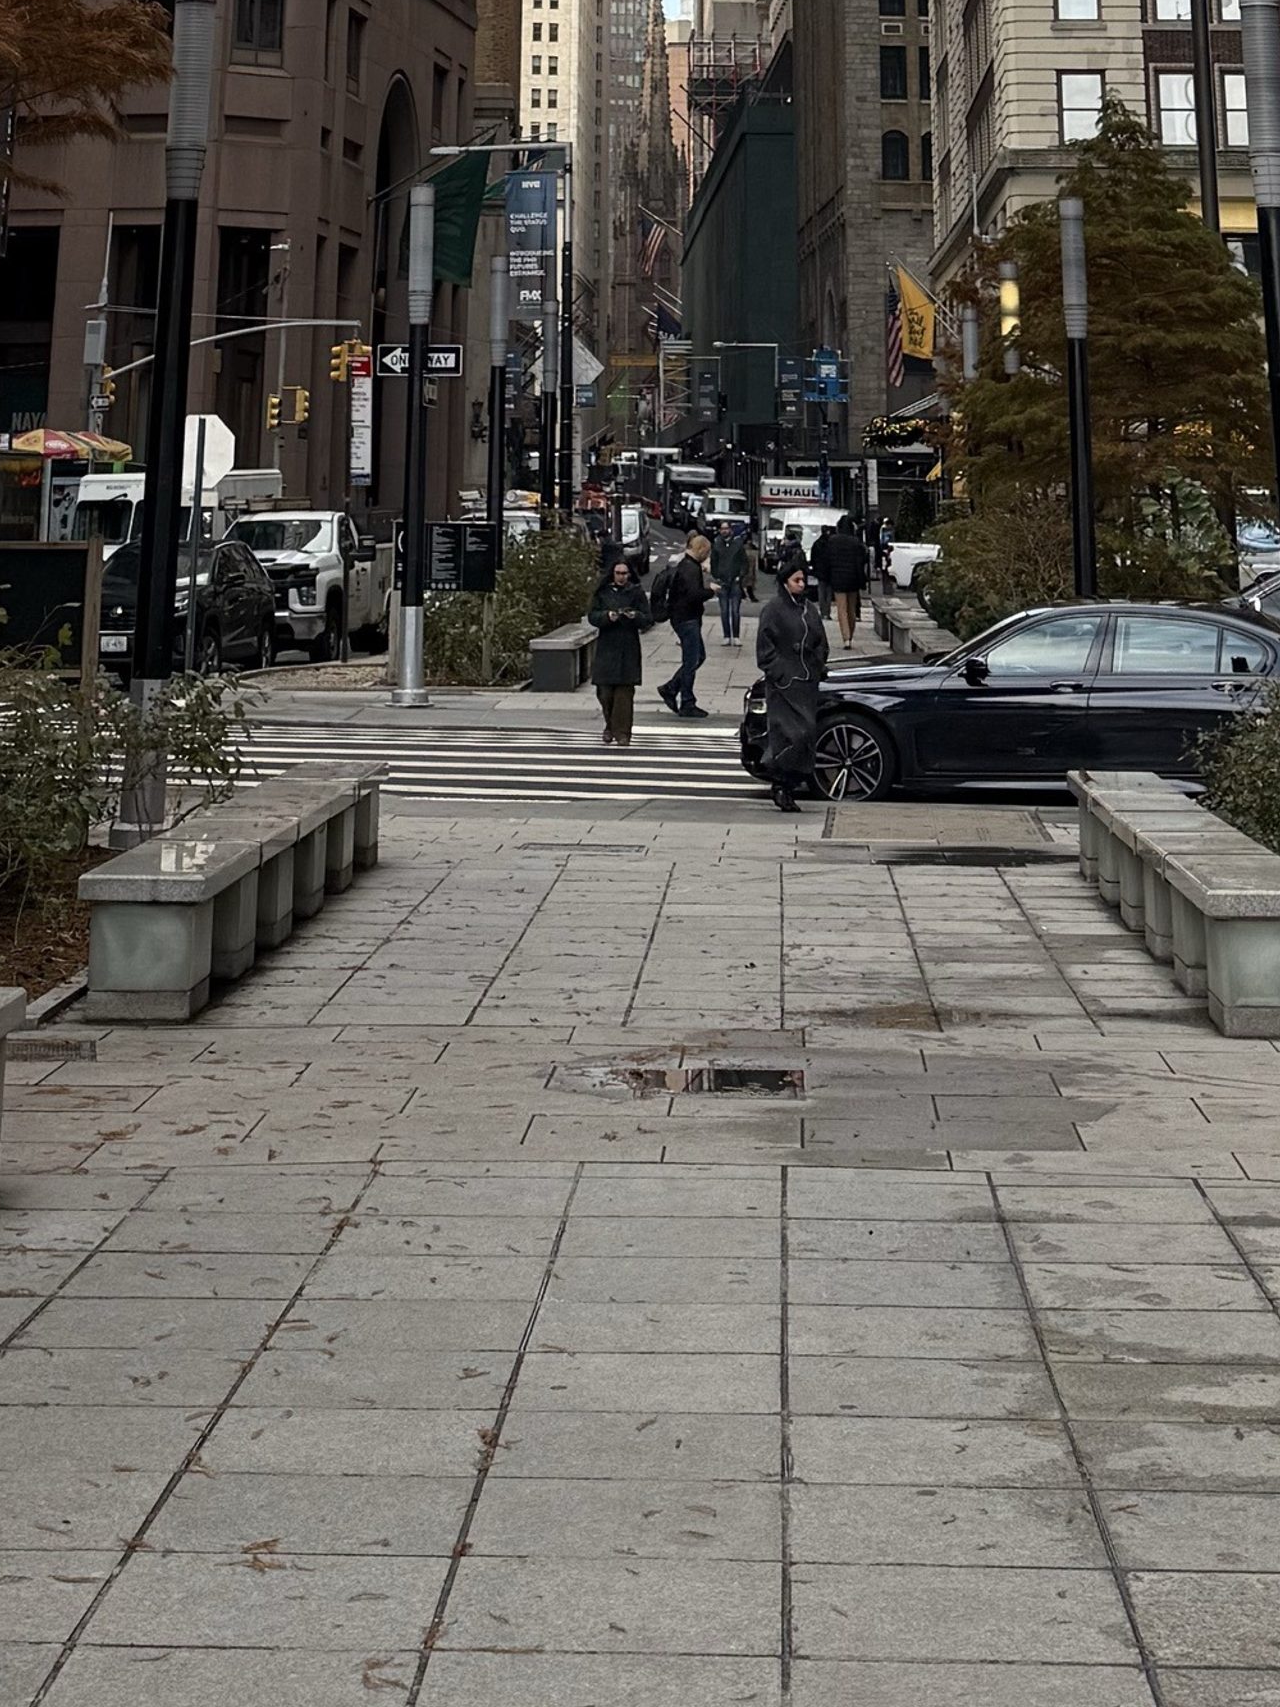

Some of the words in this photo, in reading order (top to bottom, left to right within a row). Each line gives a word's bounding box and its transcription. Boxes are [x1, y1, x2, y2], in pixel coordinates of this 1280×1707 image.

[520, 290, 542, 301] FMX
[390, 355, 407, 366] ON
[770, 488, 819, 497] U-HAUL
